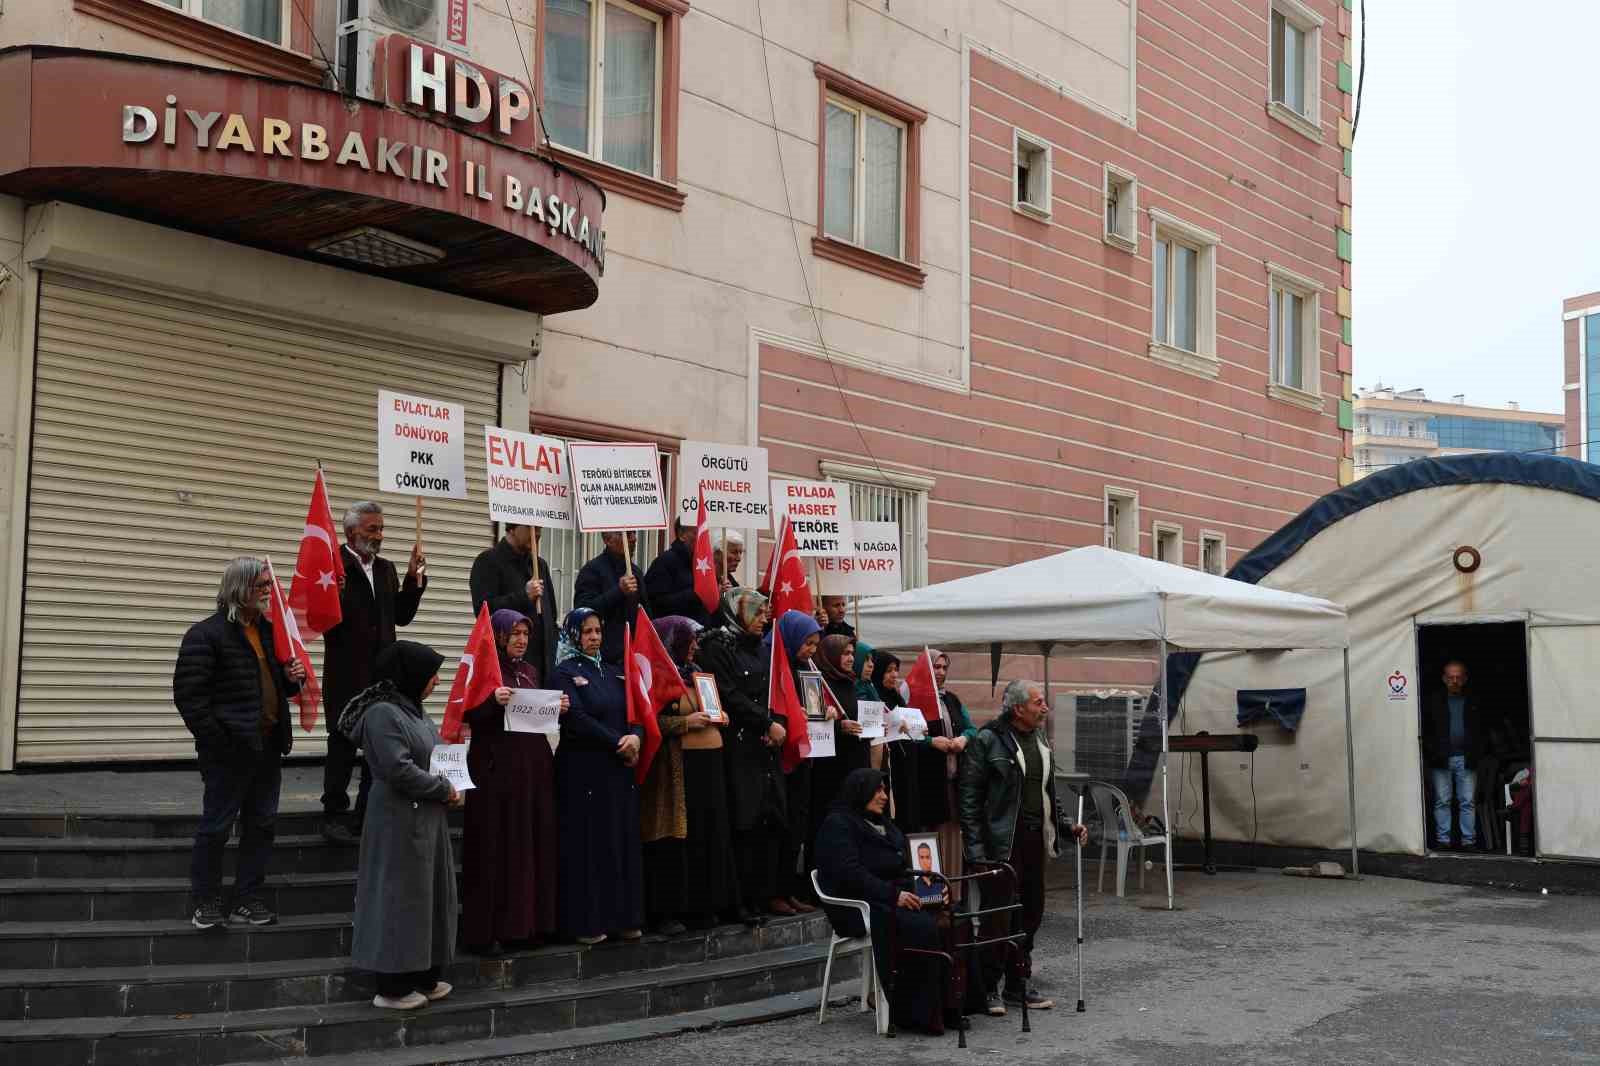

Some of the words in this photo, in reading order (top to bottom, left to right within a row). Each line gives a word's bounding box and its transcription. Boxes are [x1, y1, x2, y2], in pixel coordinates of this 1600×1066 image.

[410, 43, 531, 135] HDP
[122, 94, 449, 188] DİYARBAKIR
[394, 399, 450, 420] EVLATLAR
[394, 423, 449, 444] DÖNÜYOR
[410, 450, 434, 466] PKK
[488, 435, 562, 475] EVLAT
[701, 454, 748, 471] ÖRGÜTÜ
[582, 467, 612, 479] TERÖRÜ
[395, 472, 450, 491] ÇÖKÜYOR
[491, 474, 568, 497] NÖBETİNDEYİZ
[580, 483, 601, 493] OLAN
[700, 479, 752, 493] ANNELER
[787, 485, 836, 498] EVLADA
[788, 503, 837, 516] HASRET
[791, 519, 839, 533] TERÖRE
[863, 541, 898, 552] DAĞDA
[818, 559, 835, 570] NE
[859, 558, 895, 572] VAR?
